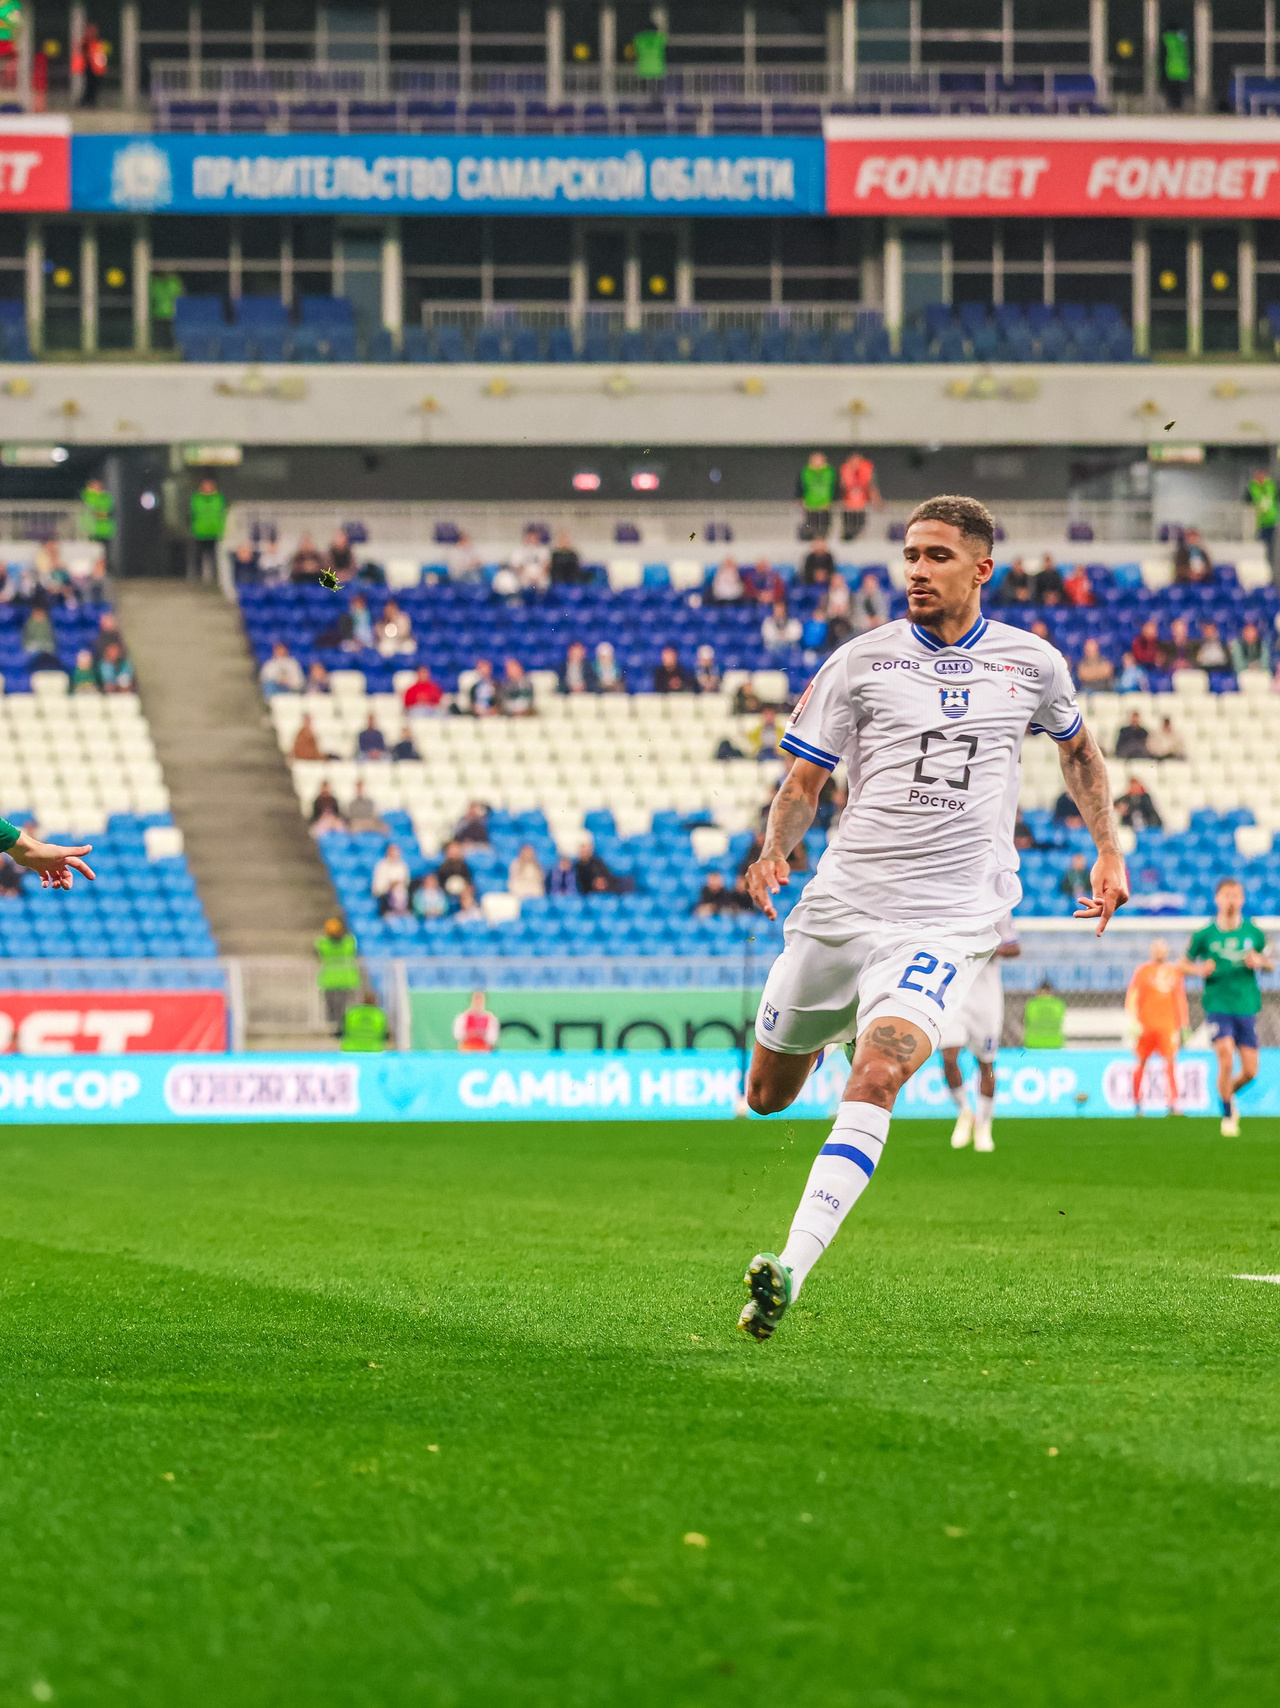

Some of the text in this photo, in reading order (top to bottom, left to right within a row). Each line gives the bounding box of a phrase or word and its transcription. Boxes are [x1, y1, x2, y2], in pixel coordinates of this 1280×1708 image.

[192, 150, 795, 201] ПРАВИТЕЛЬСТВО САМАРСКОЙ ОБЛАСТИ
[855, 156, 1280, 200] FONBET FONBET
[908, 789, 966, 812] Ростех
[897, 951, 958, 1011] 21
[458, 1062, 632, 1107] САМЫЙ
